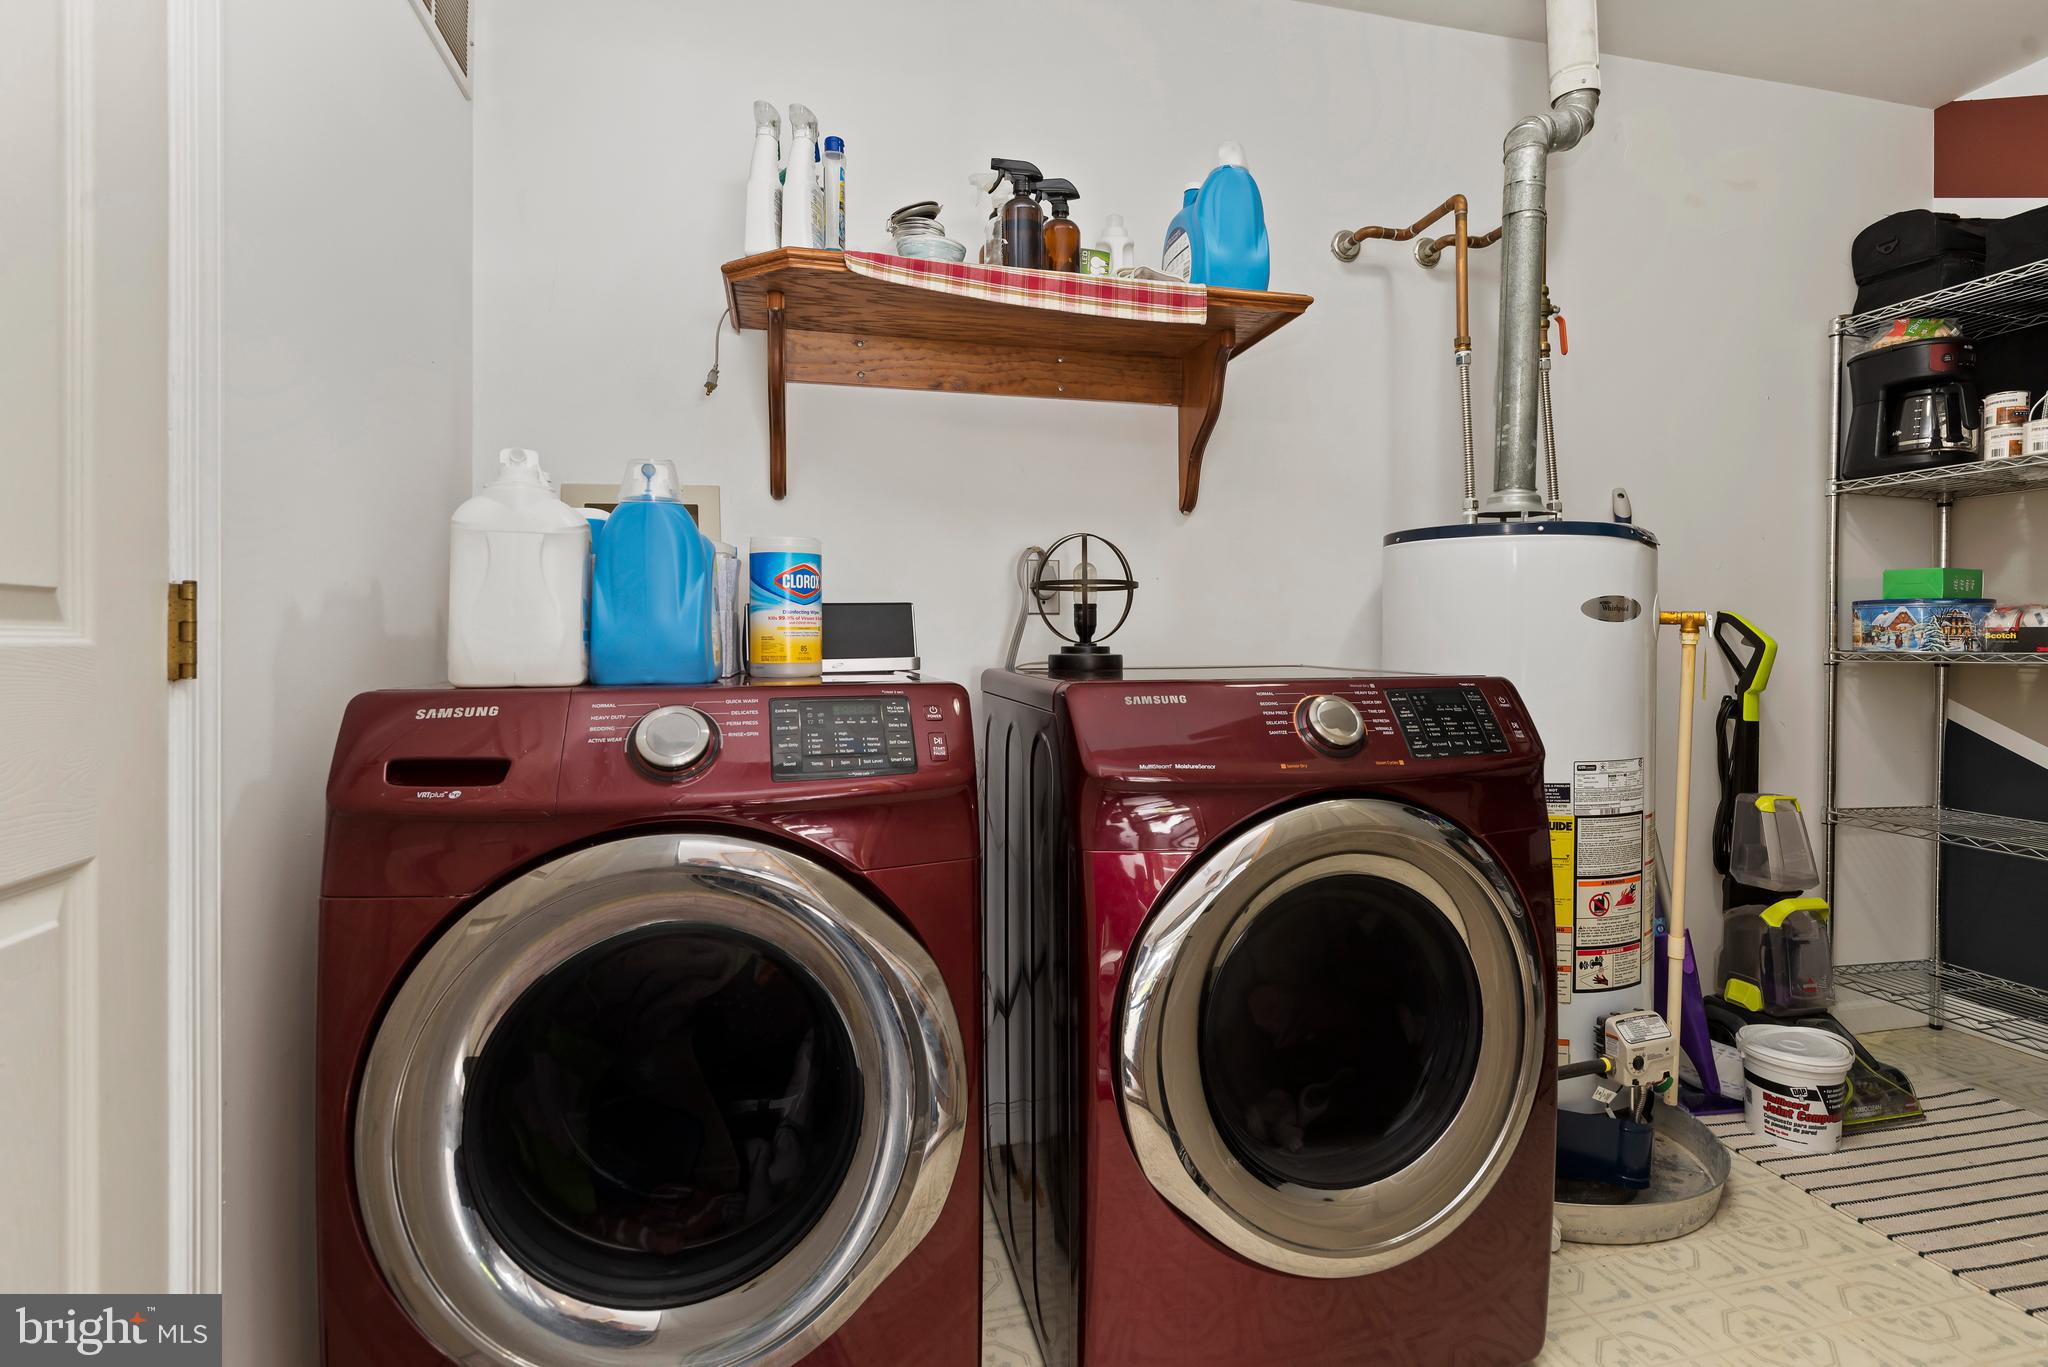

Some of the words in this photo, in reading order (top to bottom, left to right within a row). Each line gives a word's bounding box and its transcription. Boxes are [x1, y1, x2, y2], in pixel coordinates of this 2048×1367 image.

[782, 574, 820, 589] CLOROX
[1124, 695, 1187, 705] SAMSUNG
[415, 706, 499, 720] SAMSUNG
[1549, 821, 1573, 831] UIDE
[1792, 1088, 1807, 1096] DAP
[1762, 1091, 1811, 1112] Wallboard
[1762, 1102, 1795, 1120] Joint
[1763, 1113, 1793, 1126] Compuesto
[1770, 1121, 1792, 1132] paneles
